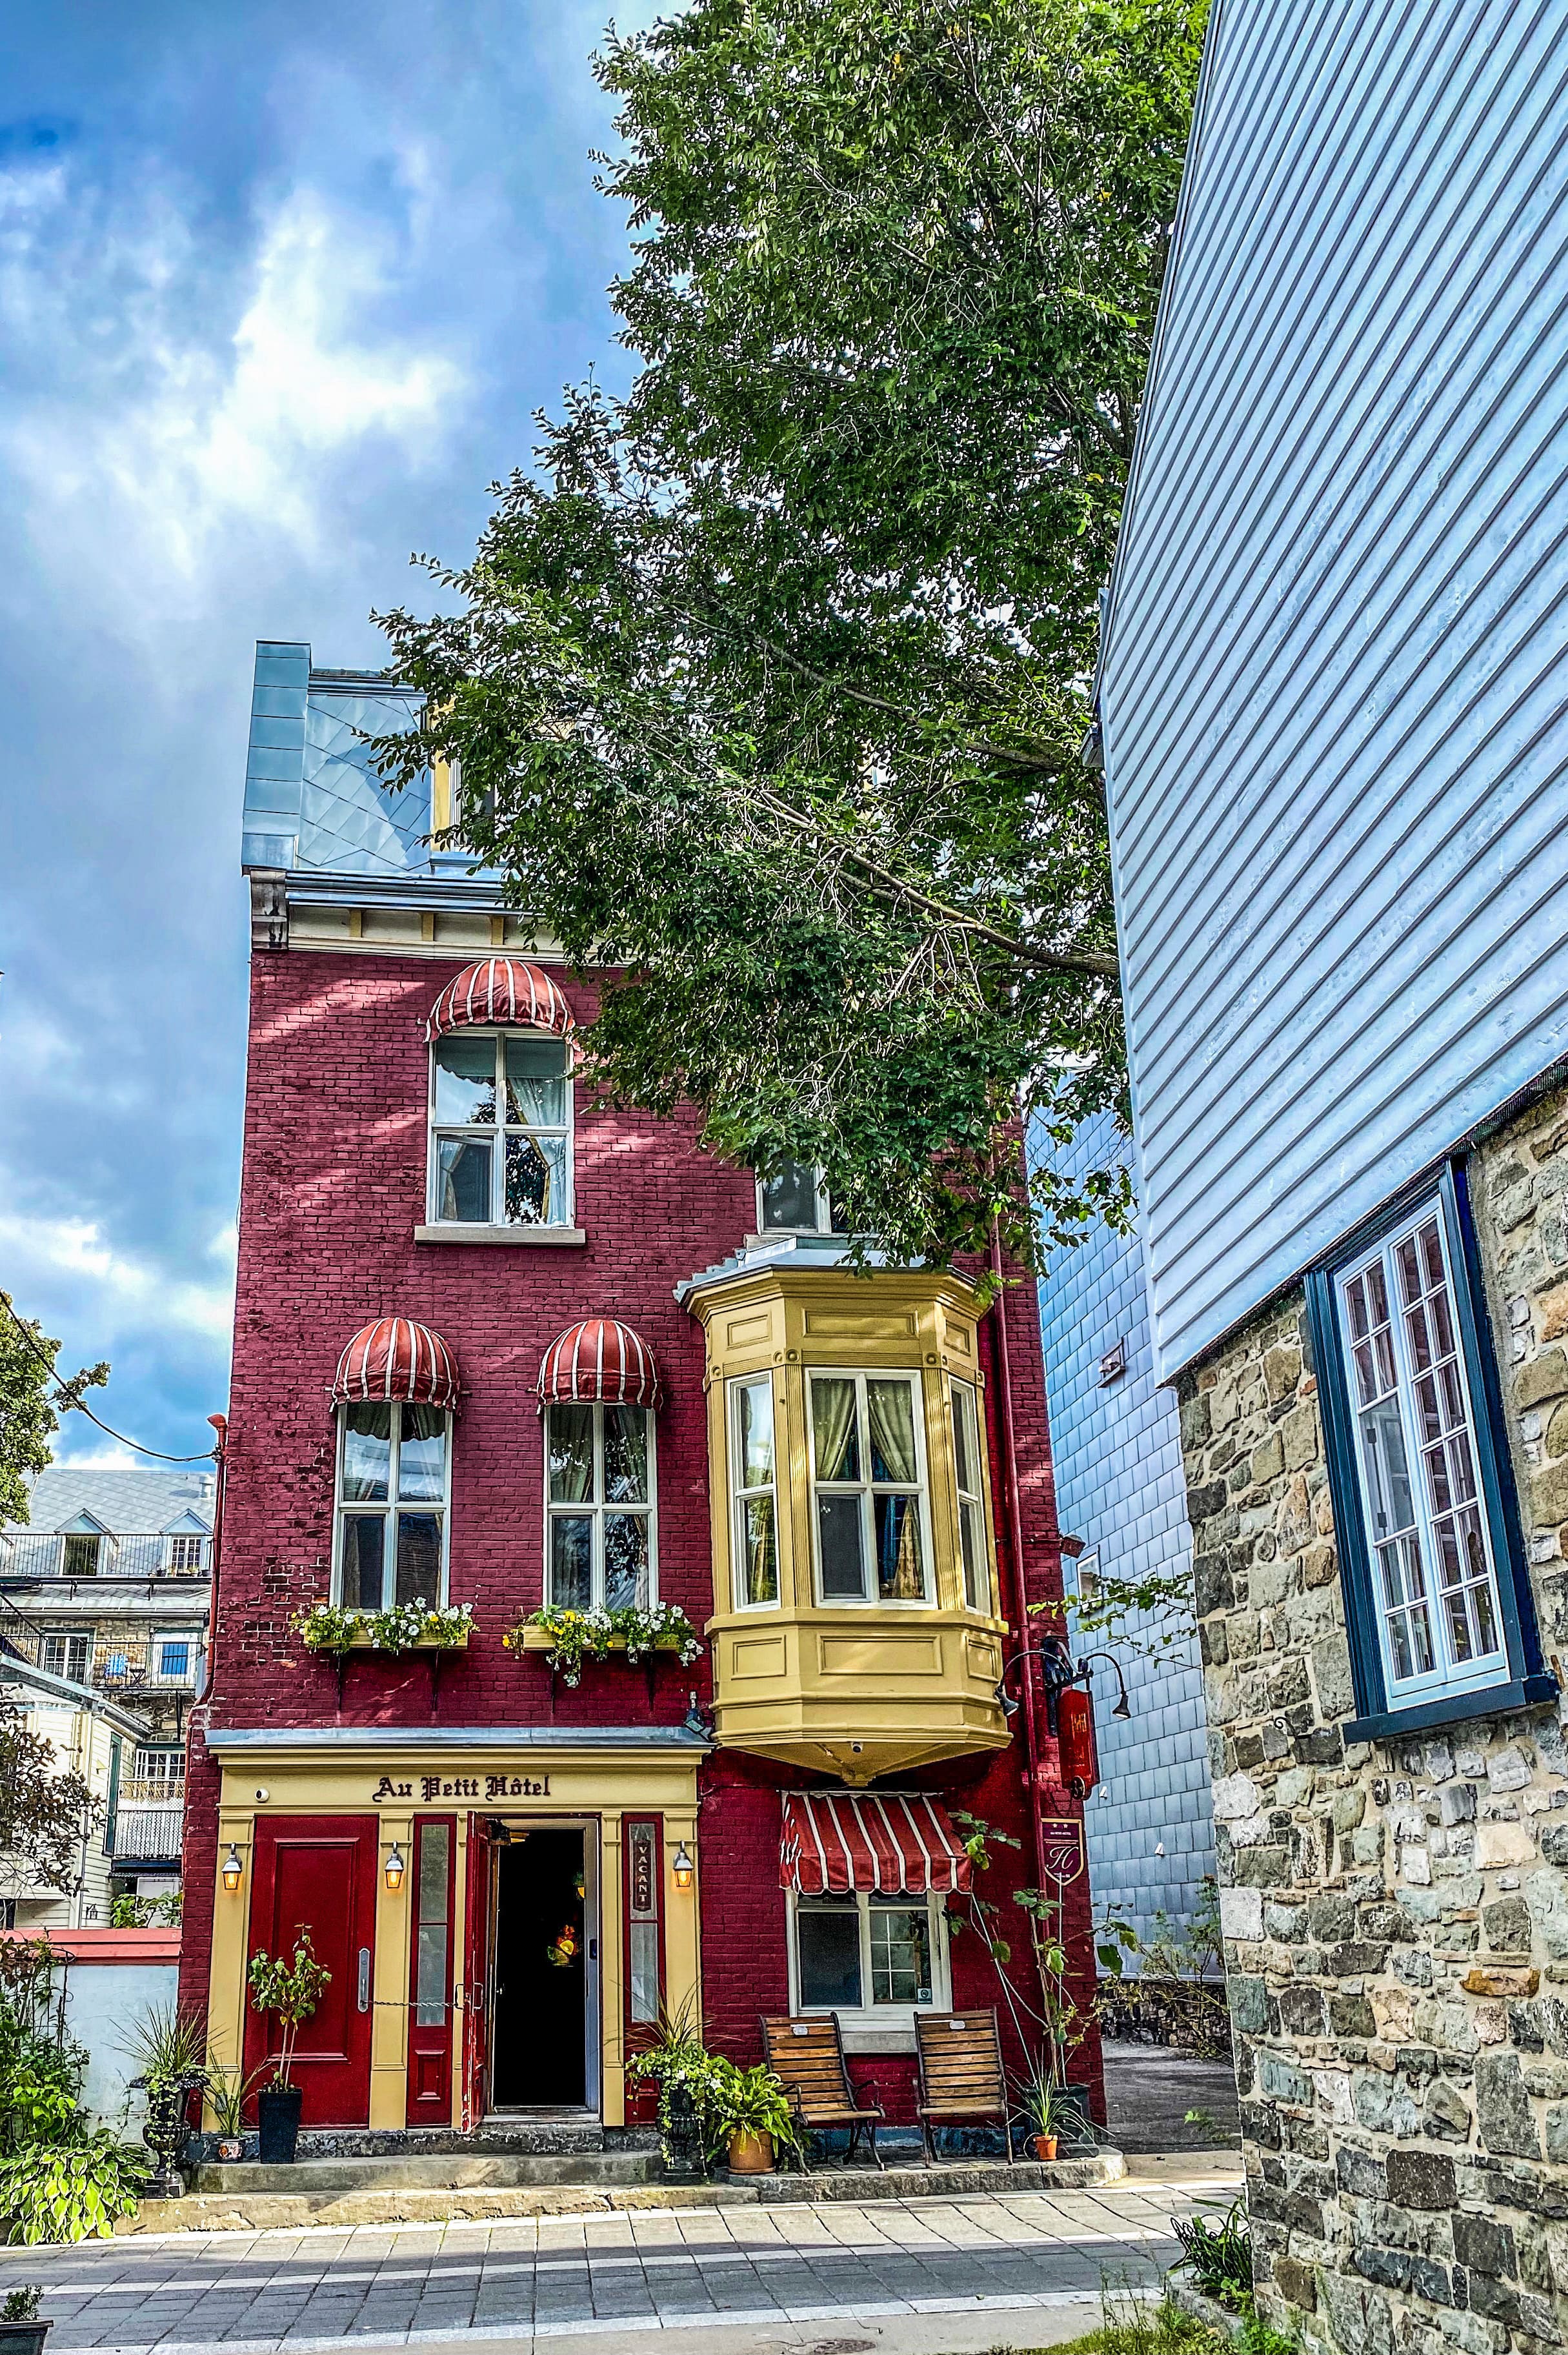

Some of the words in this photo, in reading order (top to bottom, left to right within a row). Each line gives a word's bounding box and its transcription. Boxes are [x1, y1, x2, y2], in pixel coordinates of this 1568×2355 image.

[372, 1777, 412, 1803] Au
[421, 1776, 479, 1802] Petit
[485, 1775, 550, 1801] Hôtel
[1046, 1846, 1079, 1869] H
[638, 1846, 648, 1902] VACANT
